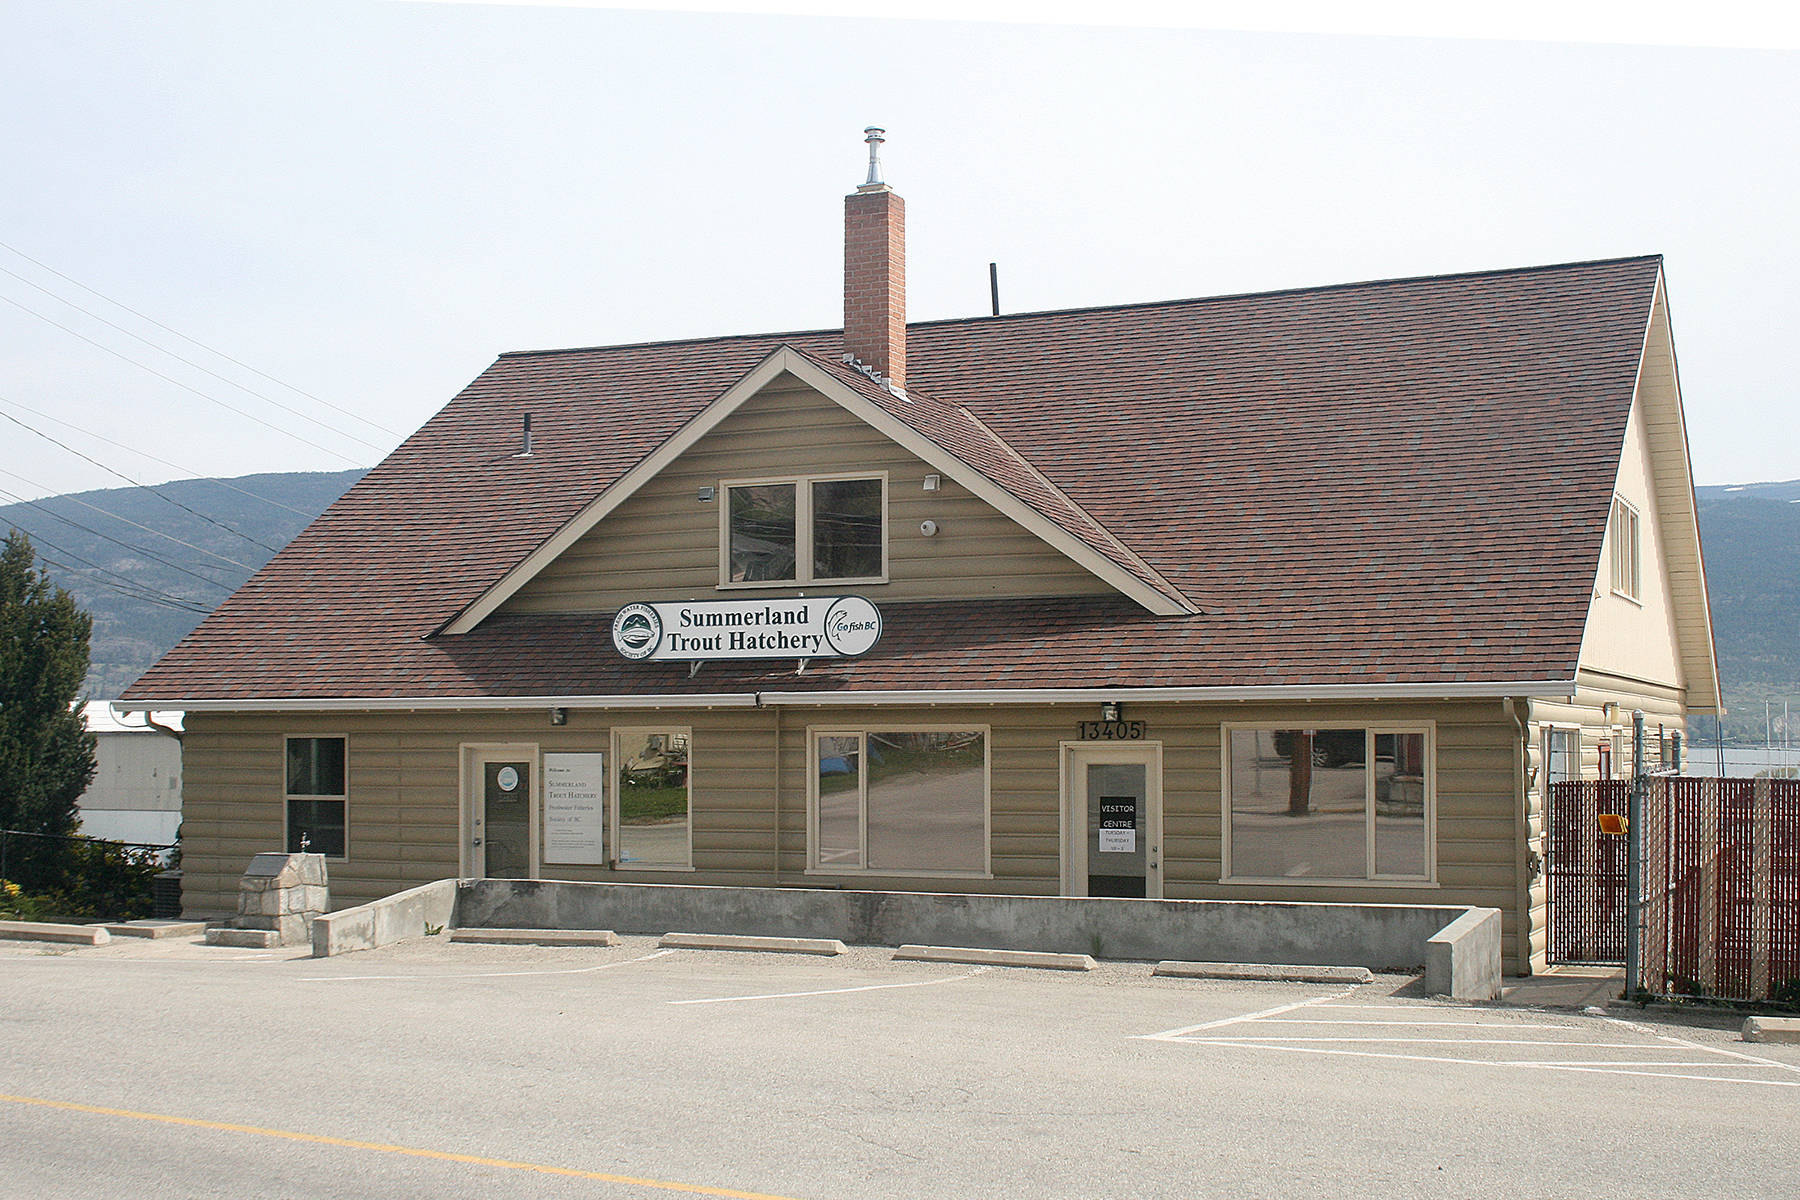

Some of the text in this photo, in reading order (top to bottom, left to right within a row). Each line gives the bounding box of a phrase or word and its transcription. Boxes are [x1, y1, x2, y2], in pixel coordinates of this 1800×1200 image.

[680, 605, 809, 628] Summerland
[837, 620, 876, 633] Go fish BC
[667, 630, 823, 653] Trout Hatchery
[1080, 721, 1140, 739] 13405
[1101, 804, 1135, 813] VISITOR
[1103, 820, 1133, 828] CENTRE
